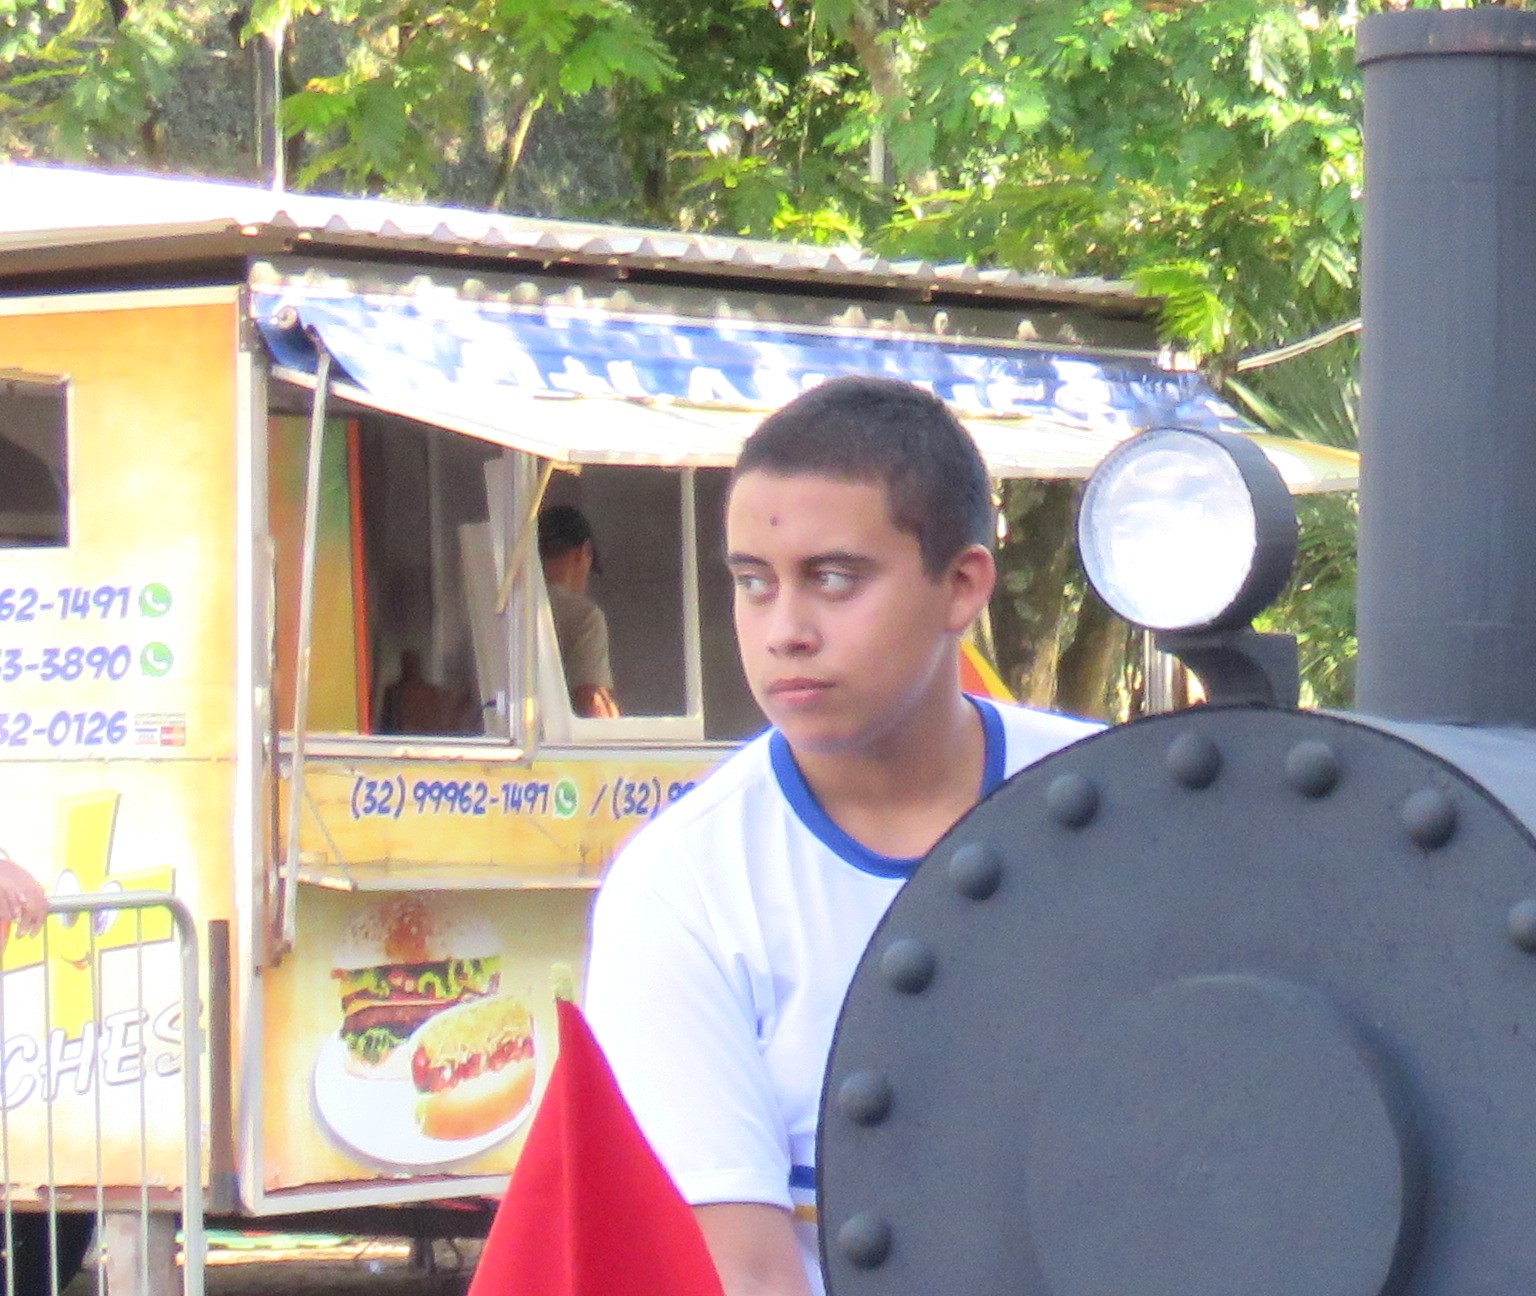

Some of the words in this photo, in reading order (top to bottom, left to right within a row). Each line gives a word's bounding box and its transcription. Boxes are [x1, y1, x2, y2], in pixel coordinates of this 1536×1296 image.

[0, 644, 132, 682] 3-3890
[350, 775, 406, 820] (32)
[413, 780, 550, 816] 99962-1491
